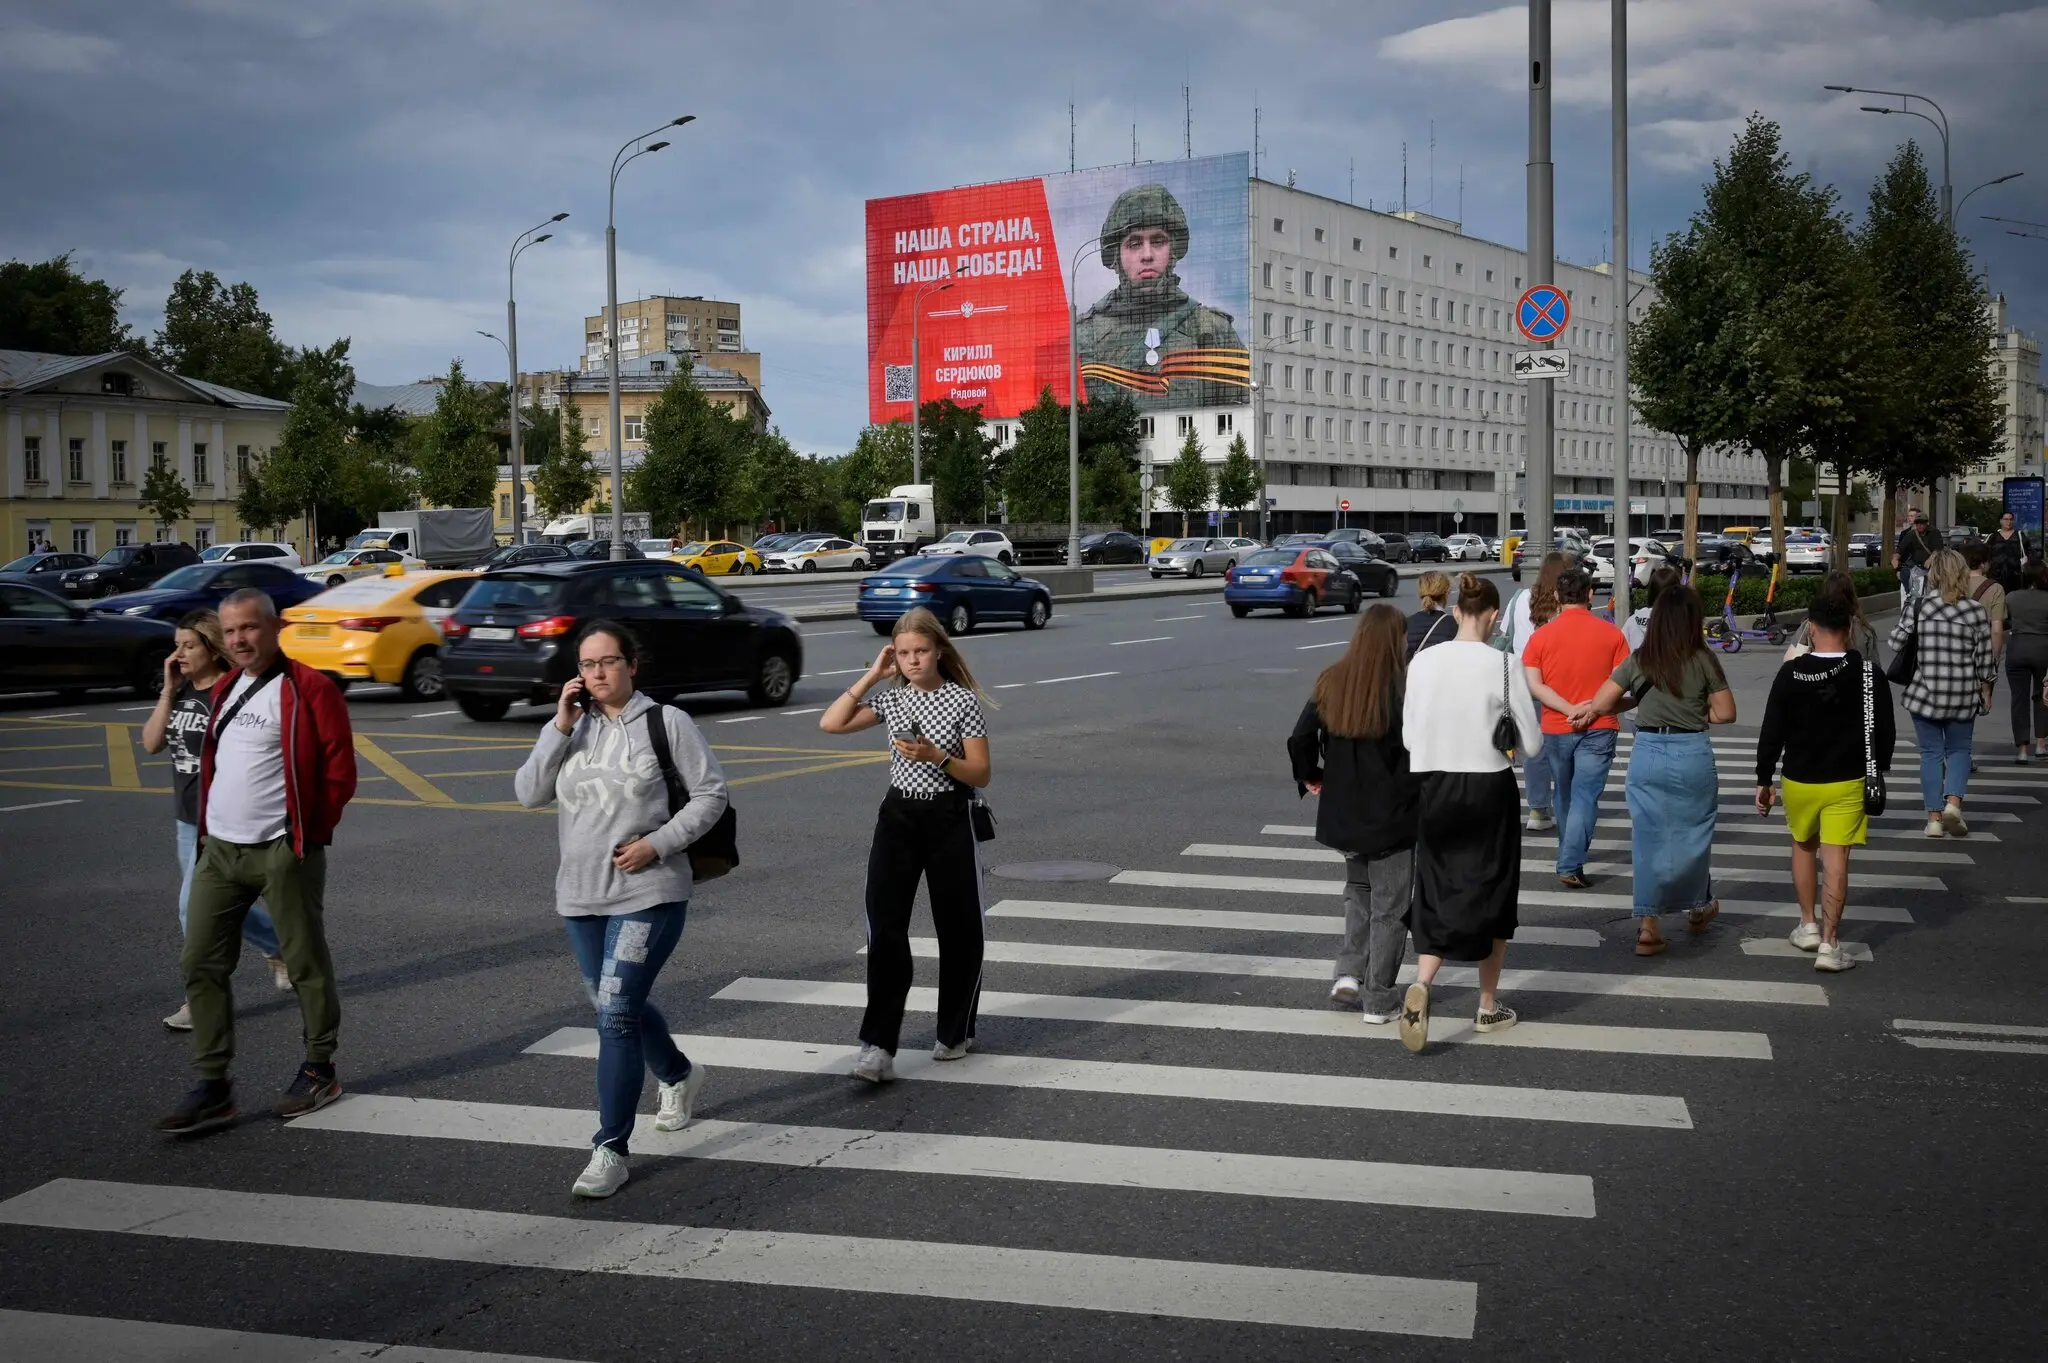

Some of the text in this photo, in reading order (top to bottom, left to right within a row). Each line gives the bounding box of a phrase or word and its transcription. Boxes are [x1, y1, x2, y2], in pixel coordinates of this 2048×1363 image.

[895, 216, 1040, 254] НАША СТРАНА,
[894, 247, 1042, 285] НАША ПОБЕДА!
[943, 344, 993, 362] КИРИЛЛ
[935, 364, 1002, 384] СЕРДЮКОВ
[950, 387, 987, 399] Рядовой
[166, 710, 210, 733] EATLES
[902, 789, 937, 801] Dior
